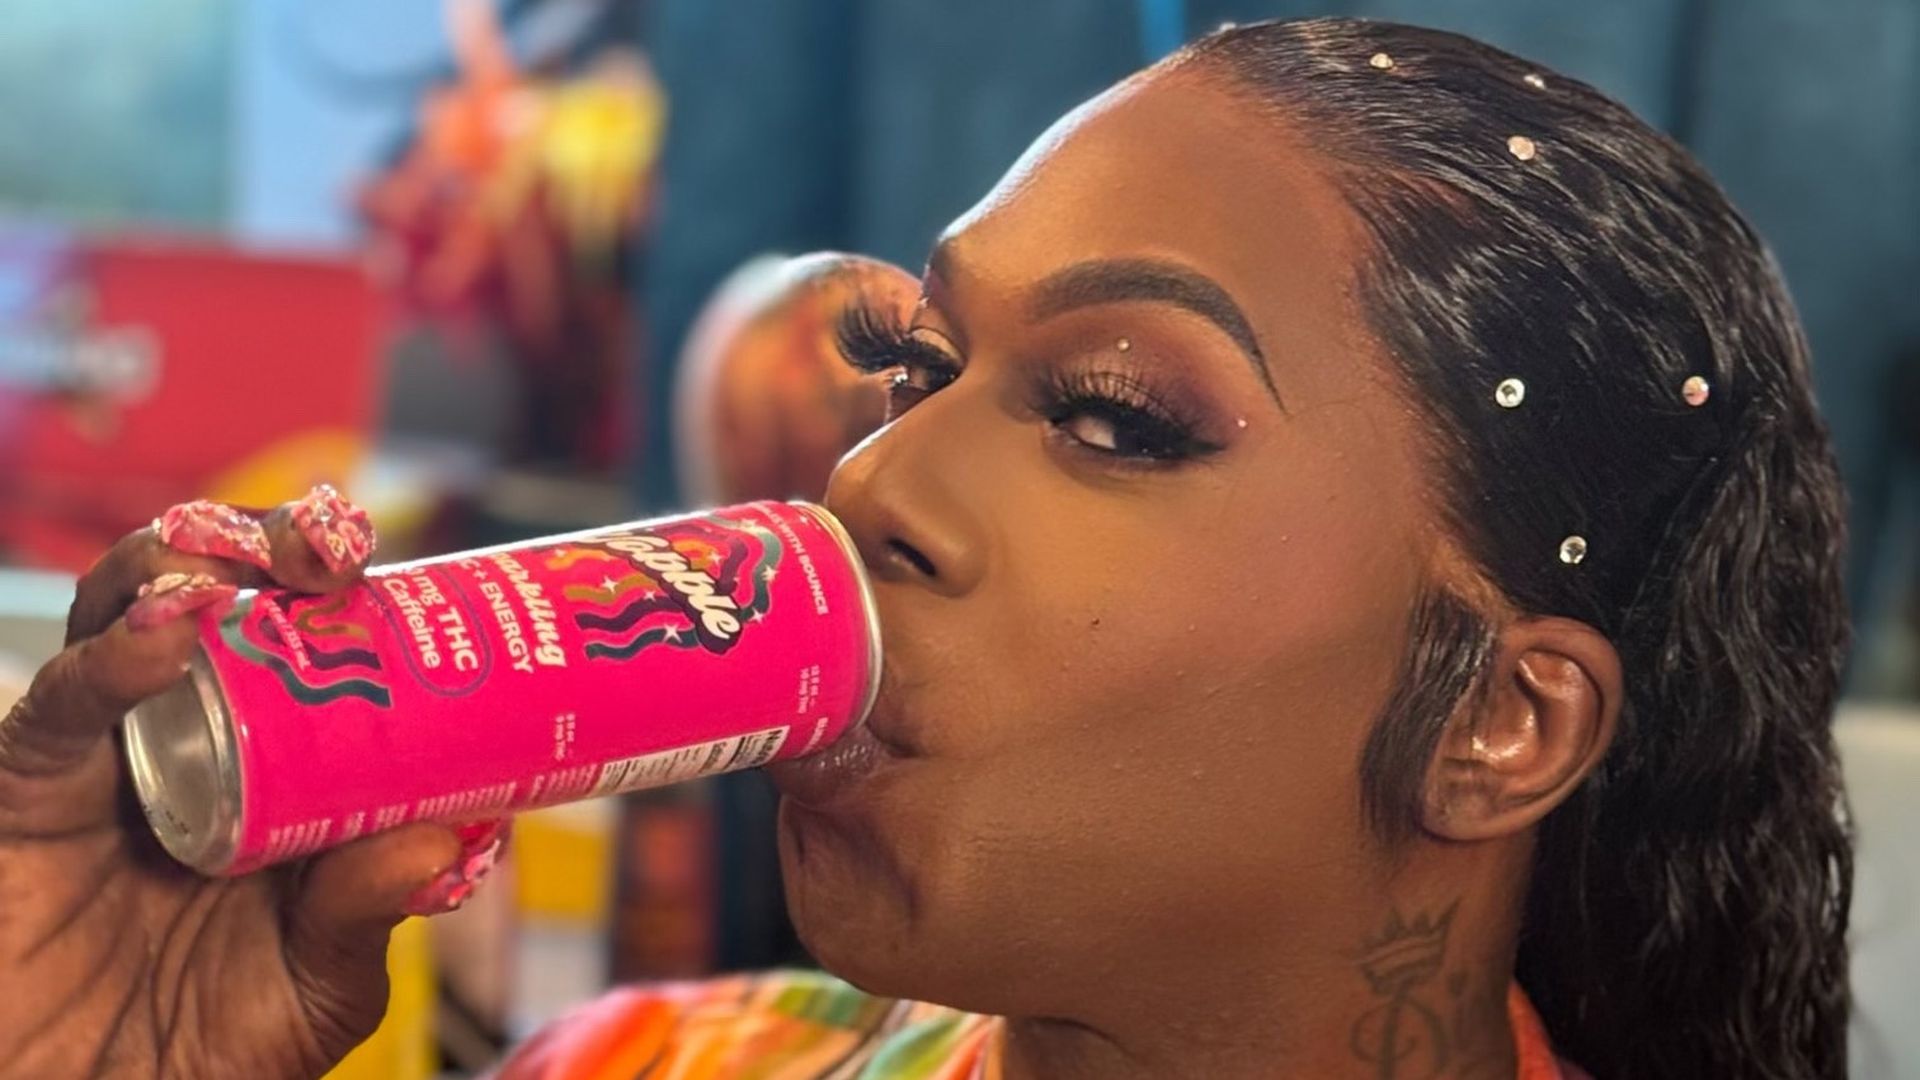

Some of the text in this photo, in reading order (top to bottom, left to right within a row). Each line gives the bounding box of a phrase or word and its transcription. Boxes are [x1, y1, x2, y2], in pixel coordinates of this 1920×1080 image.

[492, 552, 567, 667] parkling
[779, 520, 806, 554] WITH
[798, 554, 829, 616] BOUNCE
[382, 578, 442, 669] Caffeine
[412, 574, 447, 607] mg
[437, 606, 479, 672] THC
[479, 582, 534, 674] ENERGY
